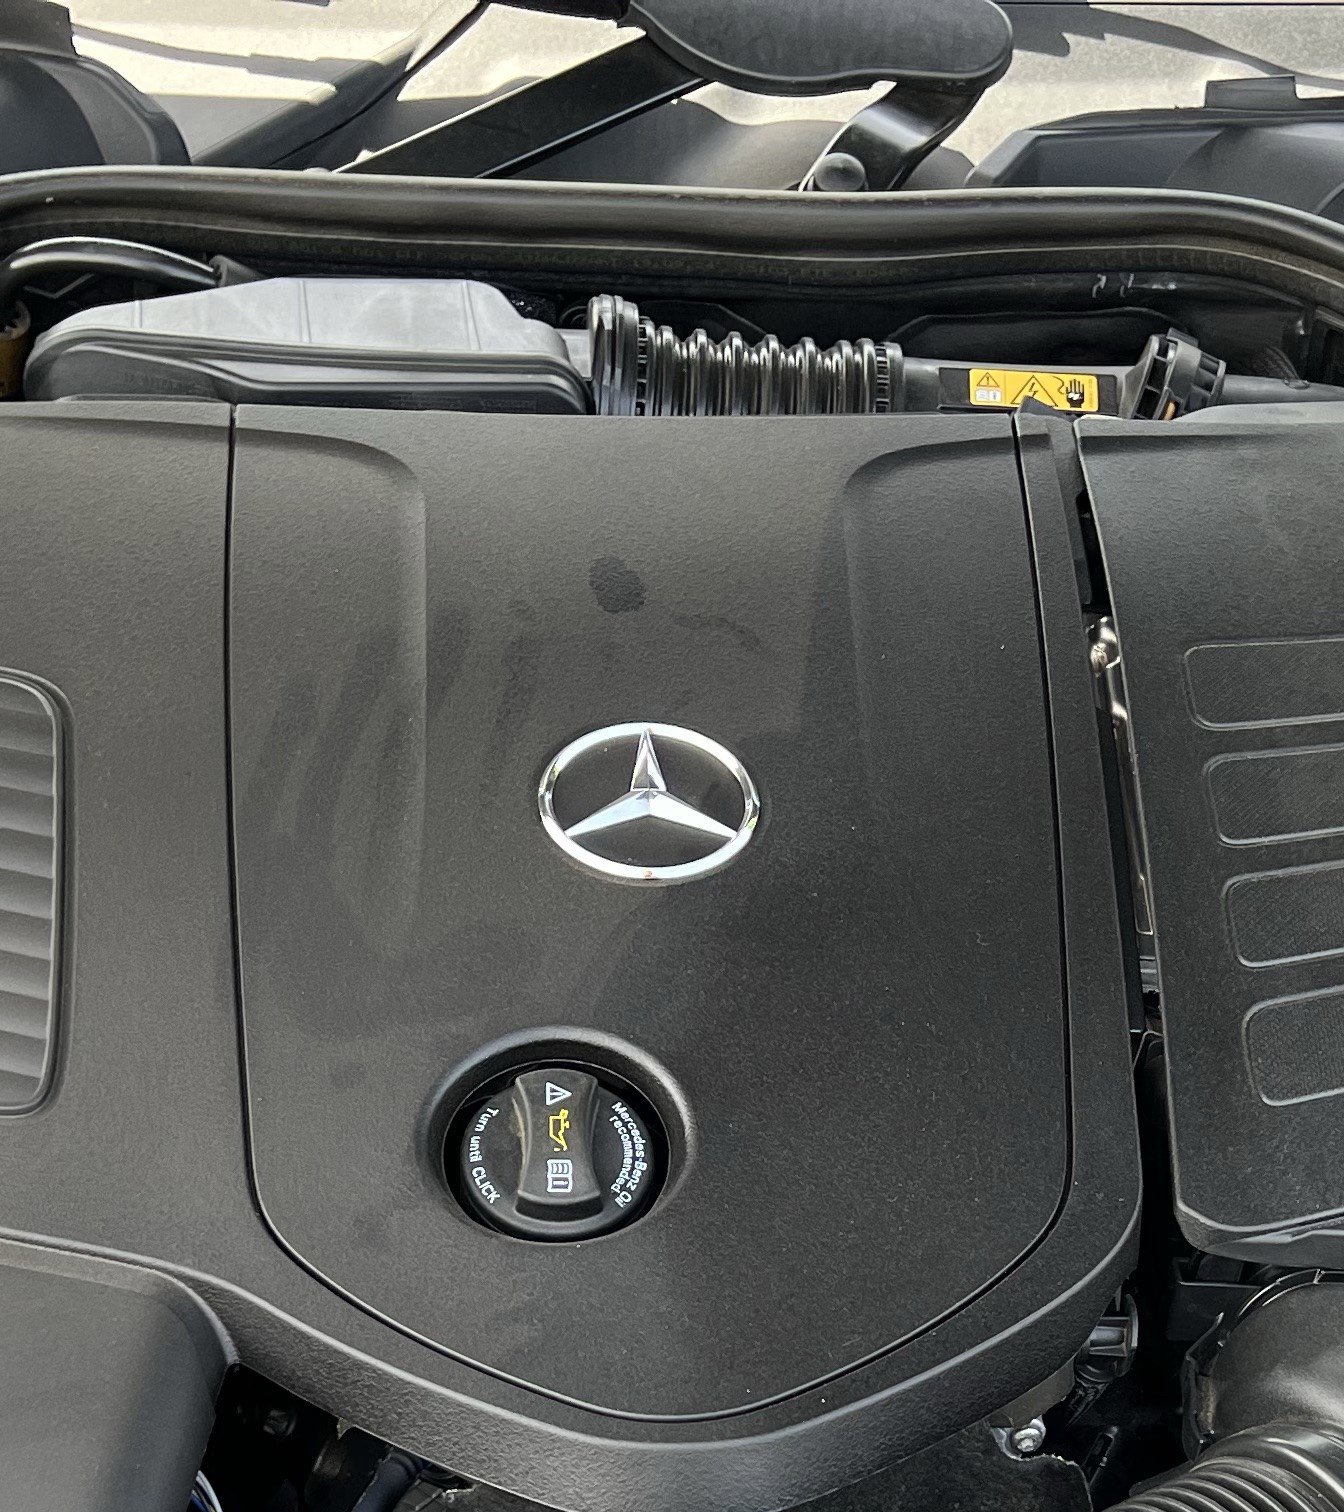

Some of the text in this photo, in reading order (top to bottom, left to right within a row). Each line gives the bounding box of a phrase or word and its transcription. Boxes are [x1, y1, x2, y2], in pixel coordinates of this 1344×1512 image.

[469, 1107, 501, 1204] Turn until CLICK
[608, 1115, 634, 1194] recommended
[611, 1101, 648, 1208] Mercedes-Benz Oil
